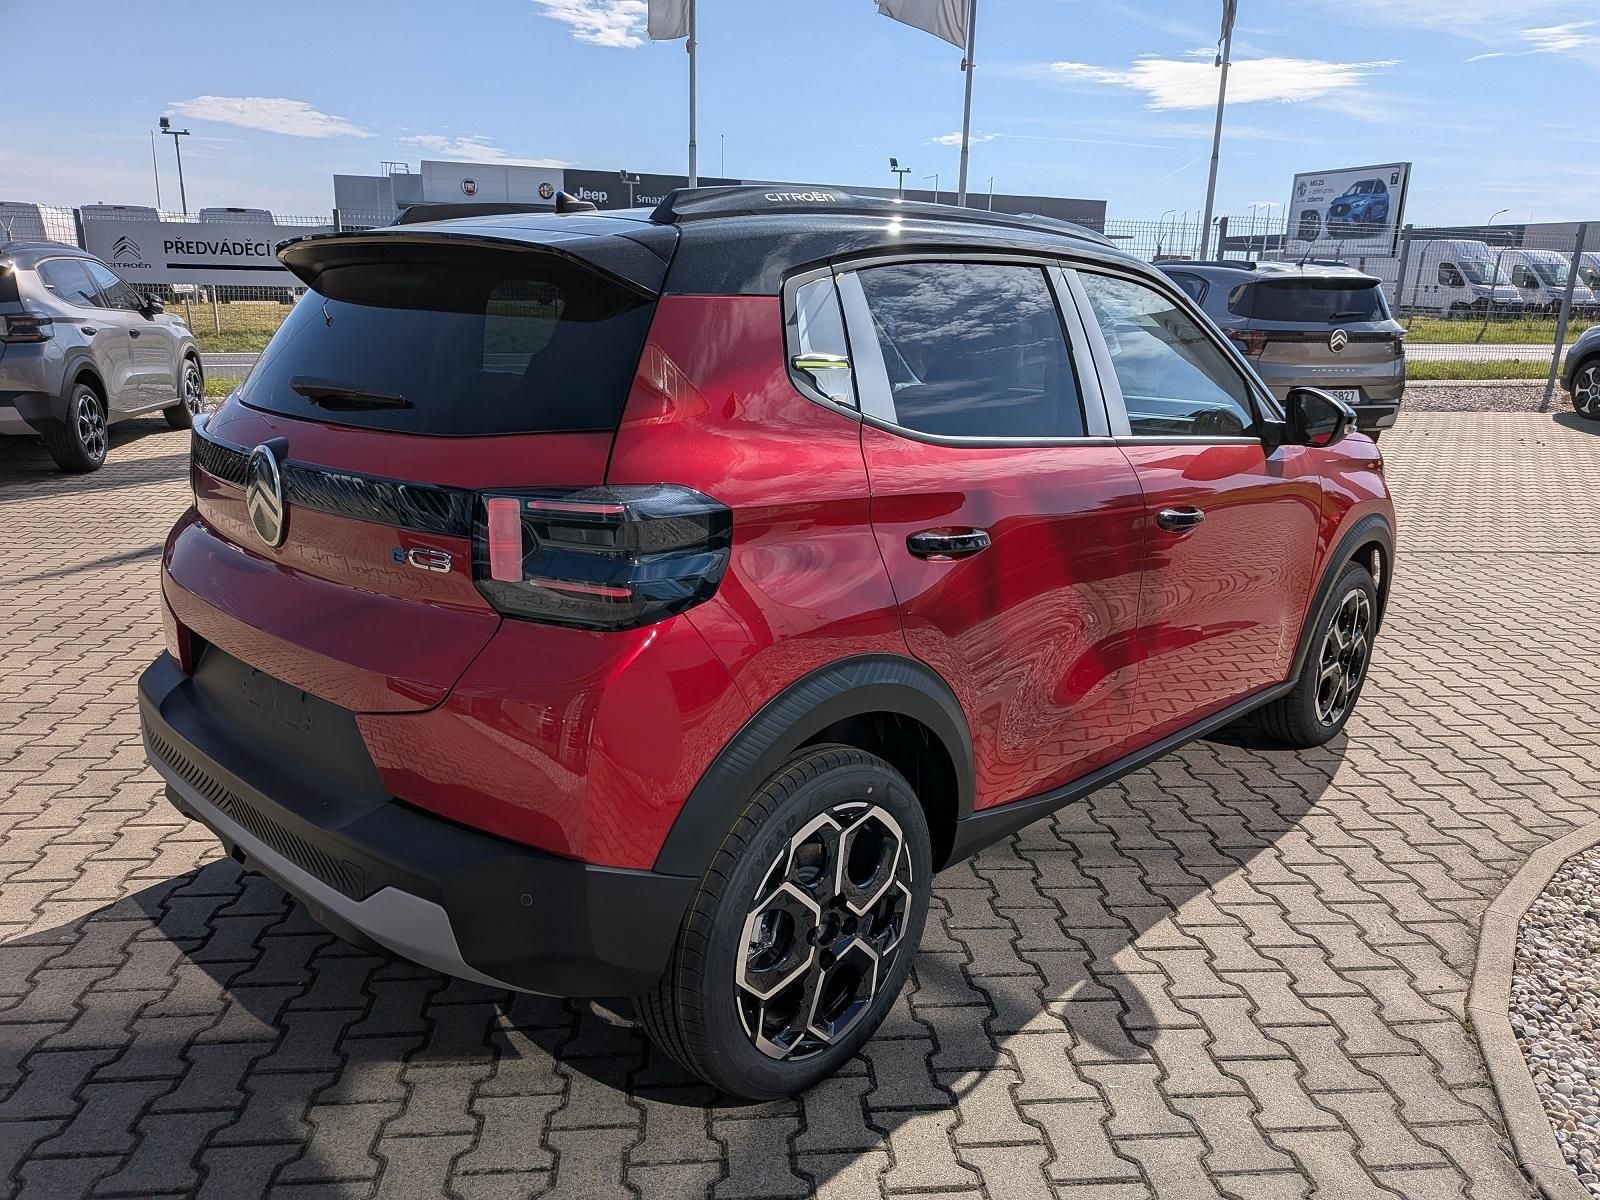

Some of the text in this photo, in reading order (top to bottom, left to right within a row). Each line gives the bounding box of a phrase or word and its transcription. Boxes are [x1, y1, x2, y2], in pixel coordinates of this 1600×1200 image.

[574, 187, 607, 203] Jeep
[636, 194, 668, 205] Smazi
[163, 236, 271, 257] PŘEDVÁDĚCÍ
